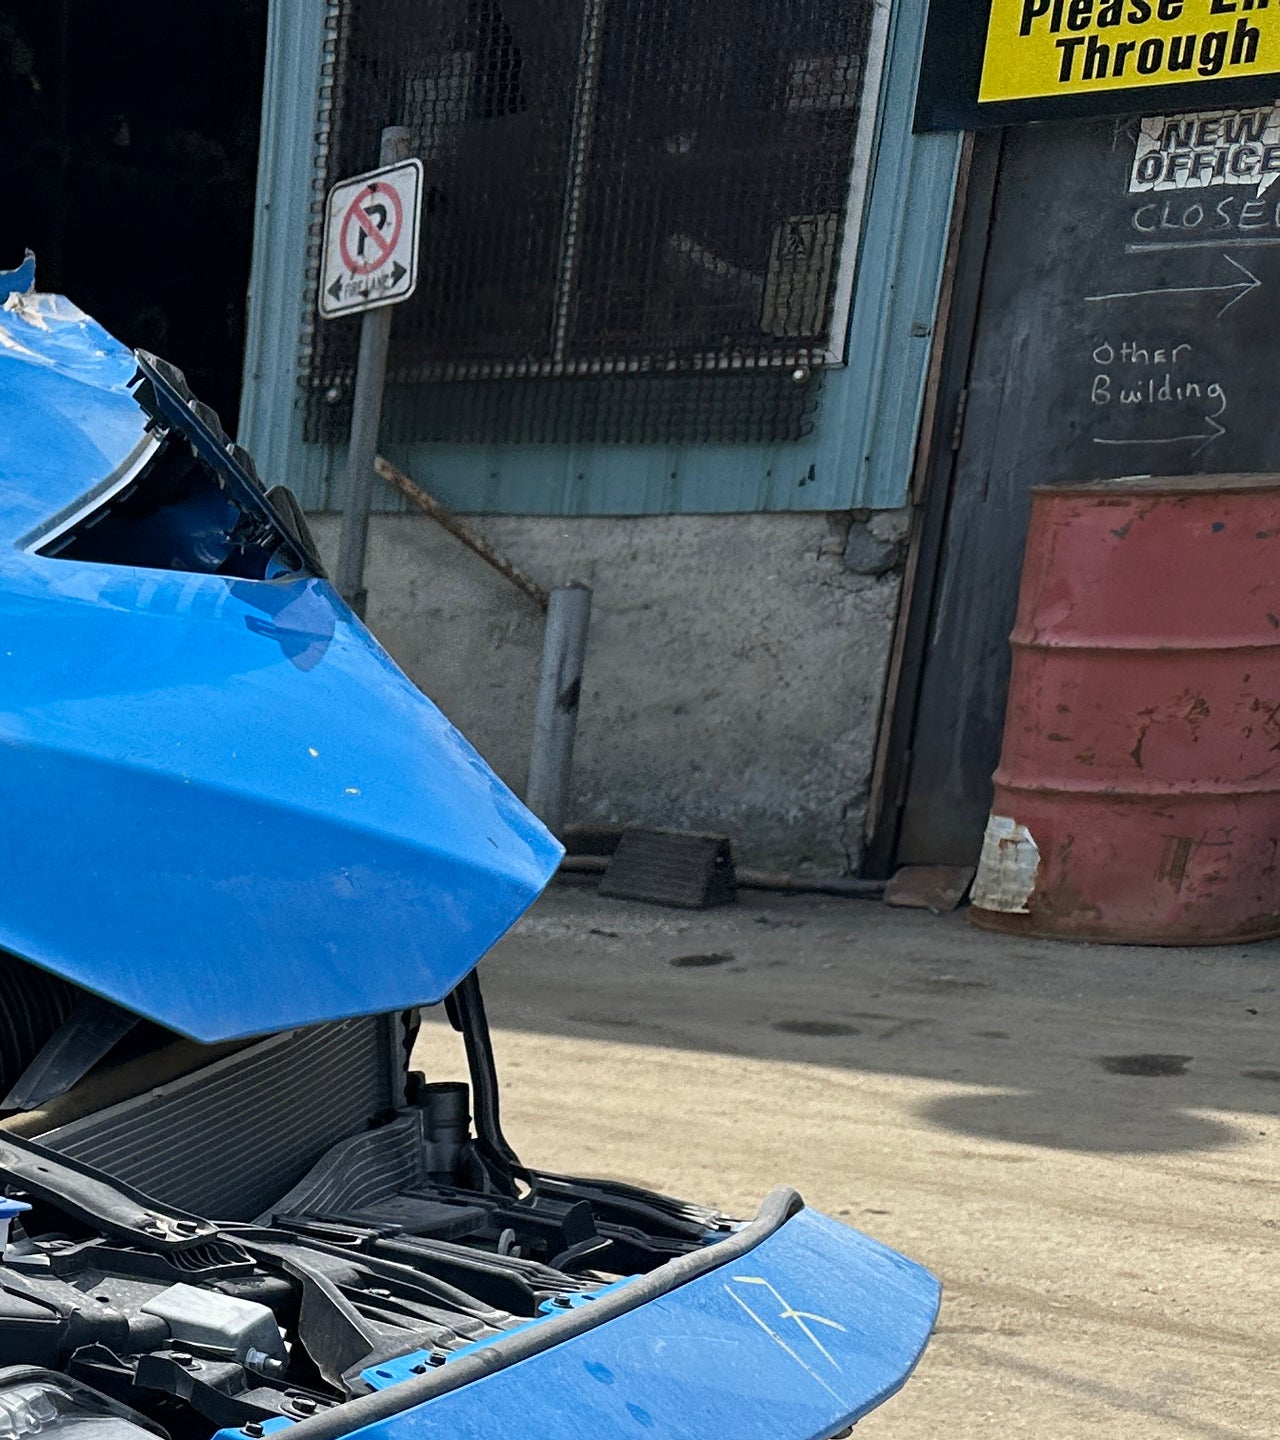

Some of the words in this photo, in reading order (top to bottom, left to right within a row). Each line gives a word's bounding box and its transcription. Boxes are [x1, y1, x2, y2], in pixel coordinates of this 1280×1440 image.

[1055, 18, 1260, 83] Through
[1161, 111, 1268, 150] NEW
[1131, 196, 1280, 232] CLOSE
[1092, 373, 1227, 418] Building
